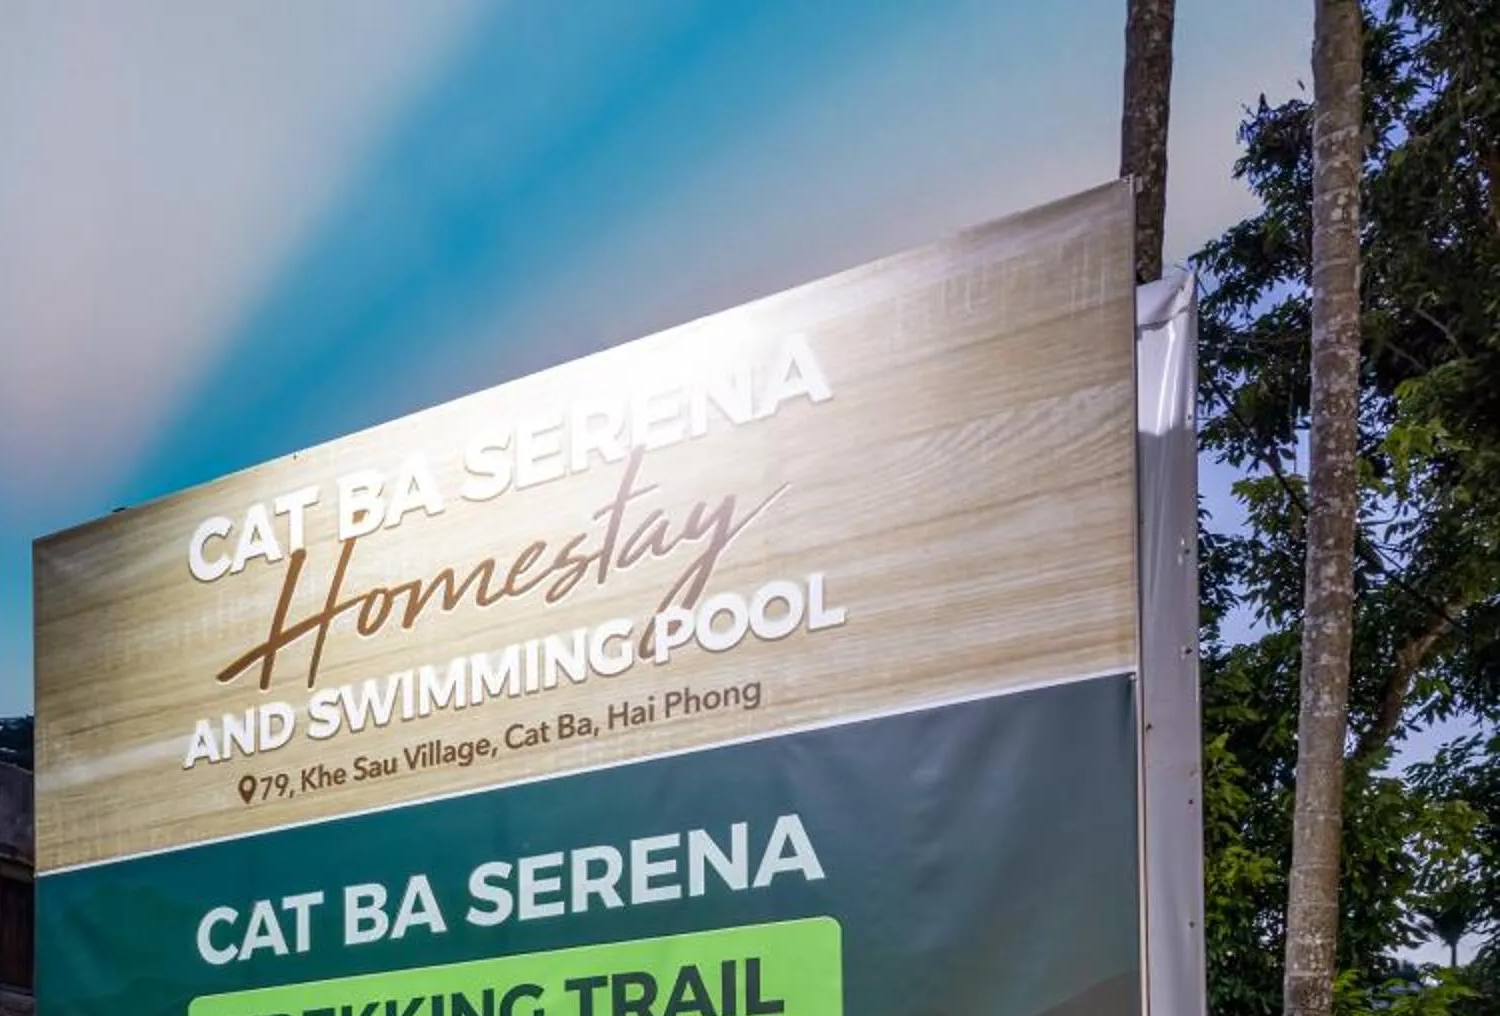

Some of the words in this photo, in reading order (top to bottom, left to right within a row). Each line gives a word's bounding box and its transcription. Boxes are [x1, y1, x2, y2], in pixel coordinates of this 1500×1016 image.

[187, 491, 319, 582] CAT
[338, 449, 445, 542] BA
[460, 331, 833, 503] SERENA
[217, 444, 792, 691] Homestay
[183, 701, 296, 769] AND
[307, 617, 633, 740] SWIMMING
[650, 573, 847, 665] POOL
[259, 773, 295, 802] 79,
[300, 761, 348, 795] Khe
[353, 752, 399, 784] Sau
[402, 733, 499, 775] Village,
[504, 718, 551, 750] Cat
[557, 712, 599, 742] Ba,
[608, 696, 656, 731] Hai
[664, 677, 763, 720] Phong
[196, 891, 325, 966] CAT
[343, 875, 448, 947] BA
[465, 812, 826, 927] SERENA
